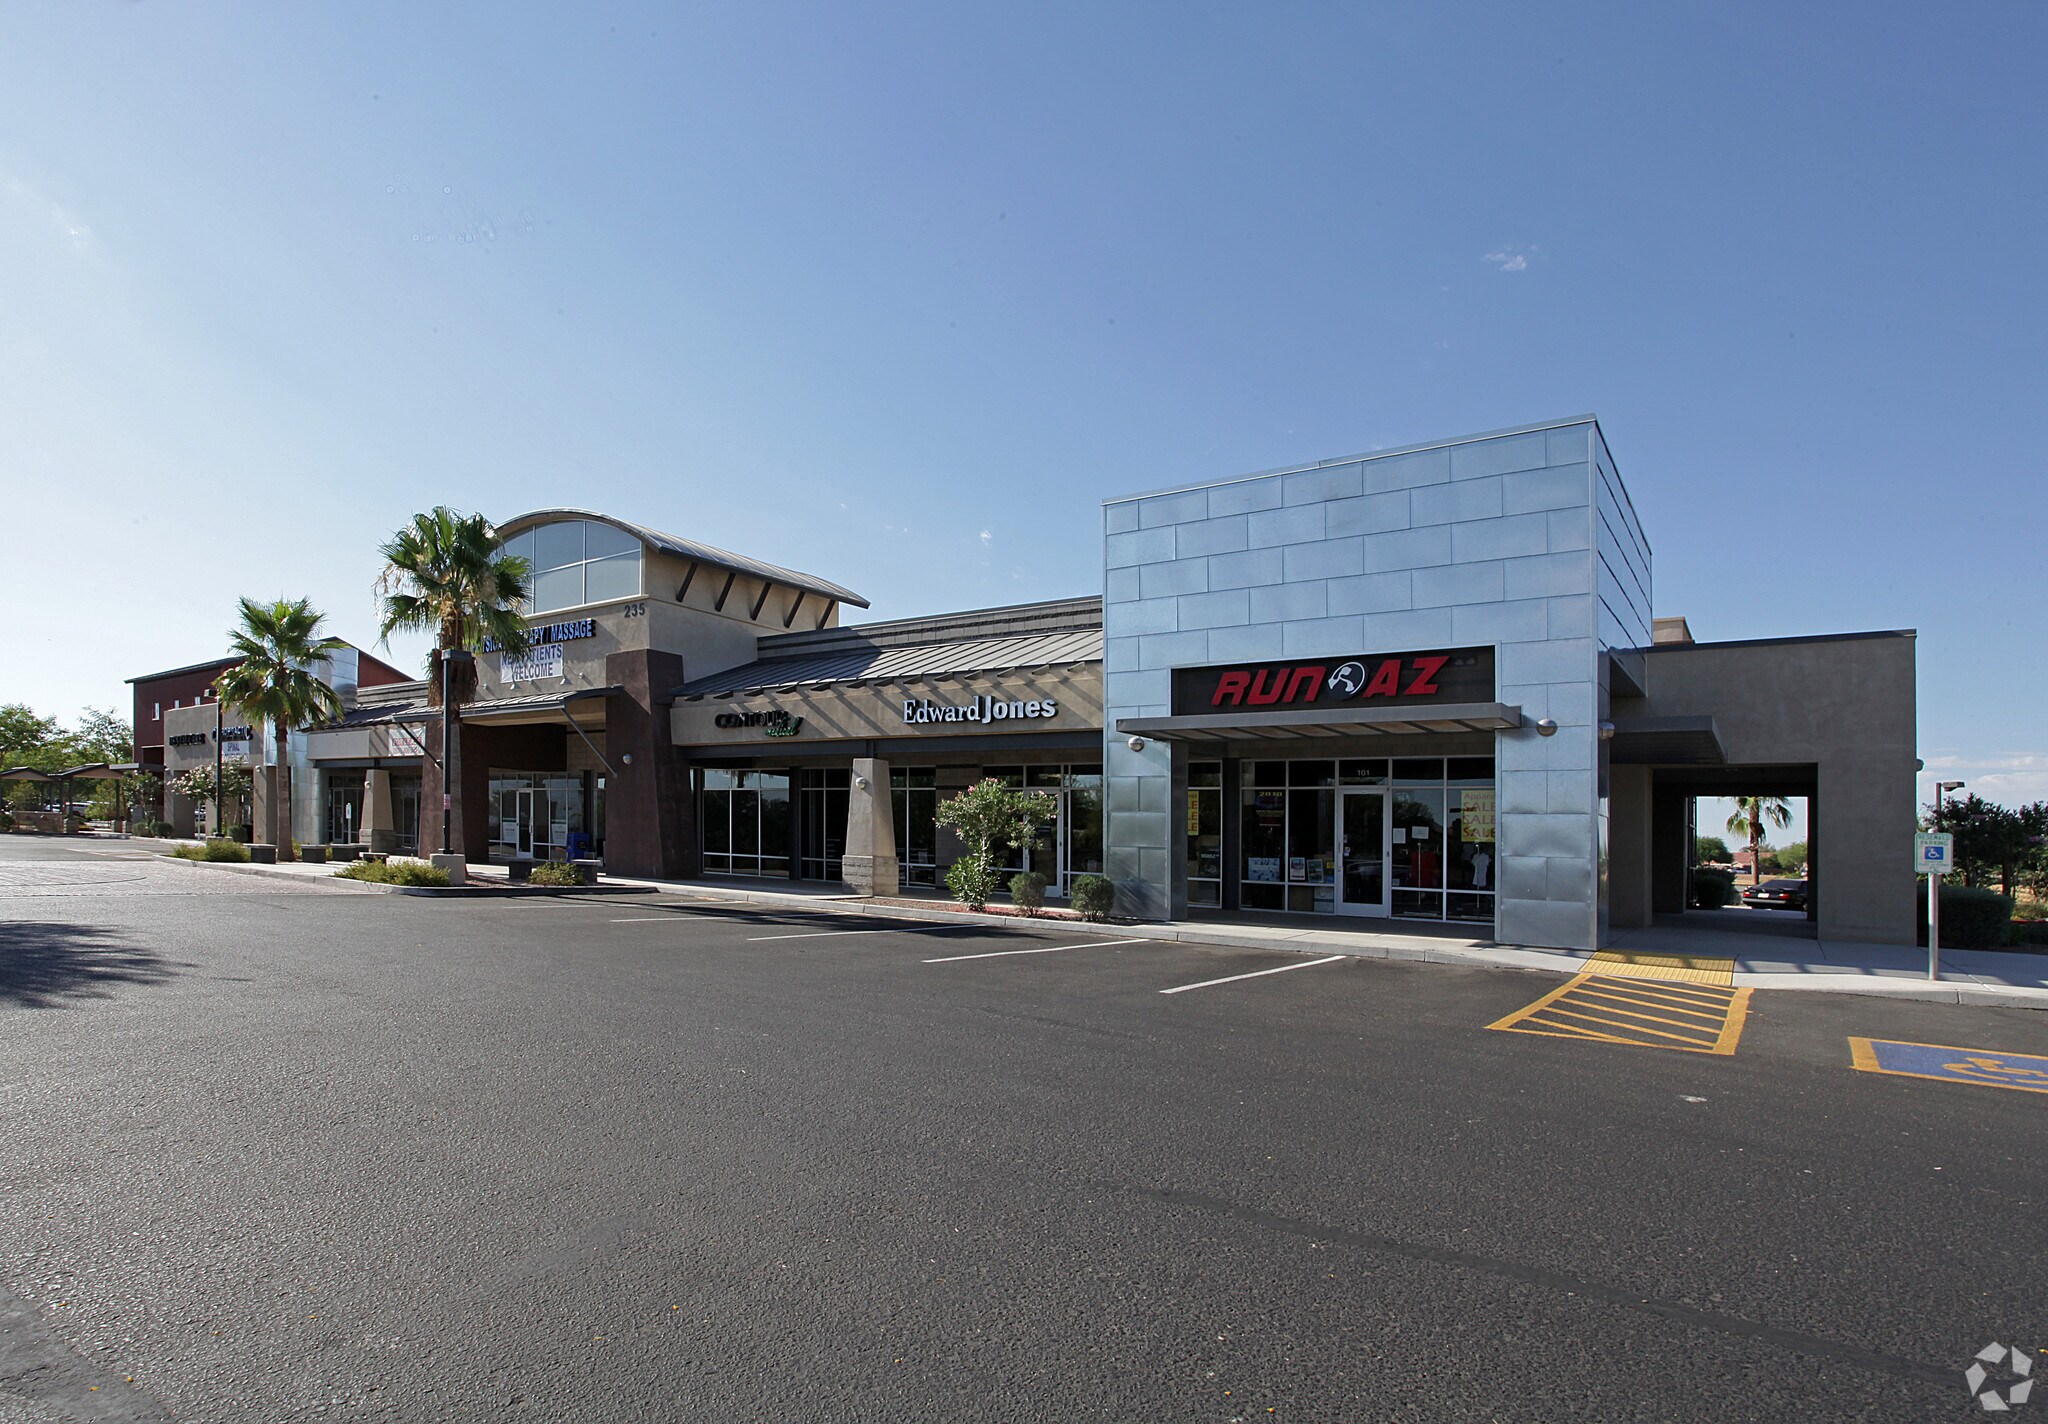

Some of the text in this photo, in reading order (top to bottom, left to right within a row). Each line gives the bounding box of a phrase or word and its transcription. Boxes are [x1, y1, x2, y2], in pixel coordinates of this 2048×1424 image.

[624, 603, 646, 618] 235
[551, 618, 593, 642] MASSAGE
[1210, 655, 1450, 706] RUN AZ
[902, 695, 1057, 724] Edward Jones
[1463, 801, 1495, 812] SALE
[1463, 814, 1495, 825] SALE
[1463, 827, 1495, 838] SALE
